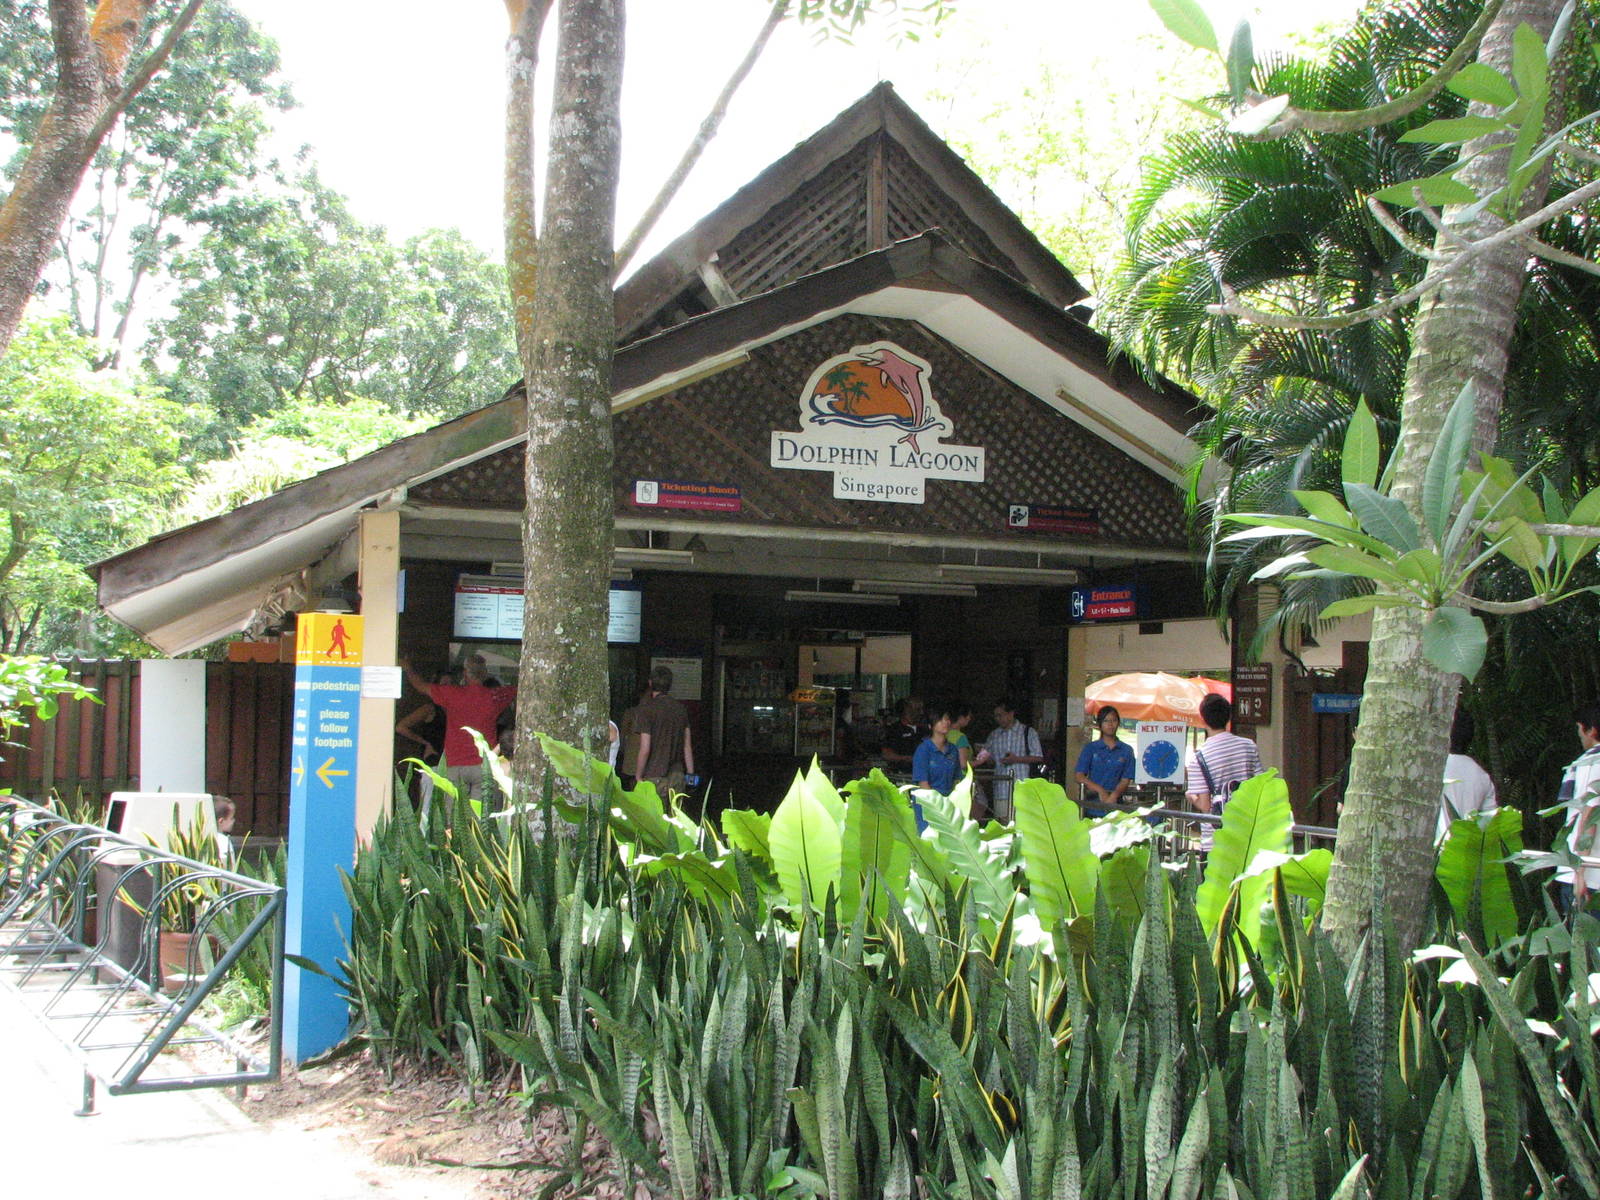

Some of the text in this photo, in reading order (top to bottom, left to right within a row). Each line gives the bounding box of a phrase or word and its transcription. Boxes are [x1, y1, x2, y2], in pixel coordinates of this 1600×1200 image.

[661, 483, 706, 494] Ticketing
[840, 477, 919, 499] Singapore
[1091, 590, 1131, 601] Entrance
[311, 680, 361, 692] pedestrian
[319, 709, 350, 720] please
[319, 722, 349, 734] follow
[1141, 725, 1184, 733] NEXT SHOW
[313, 737, 353, 749] footpath
